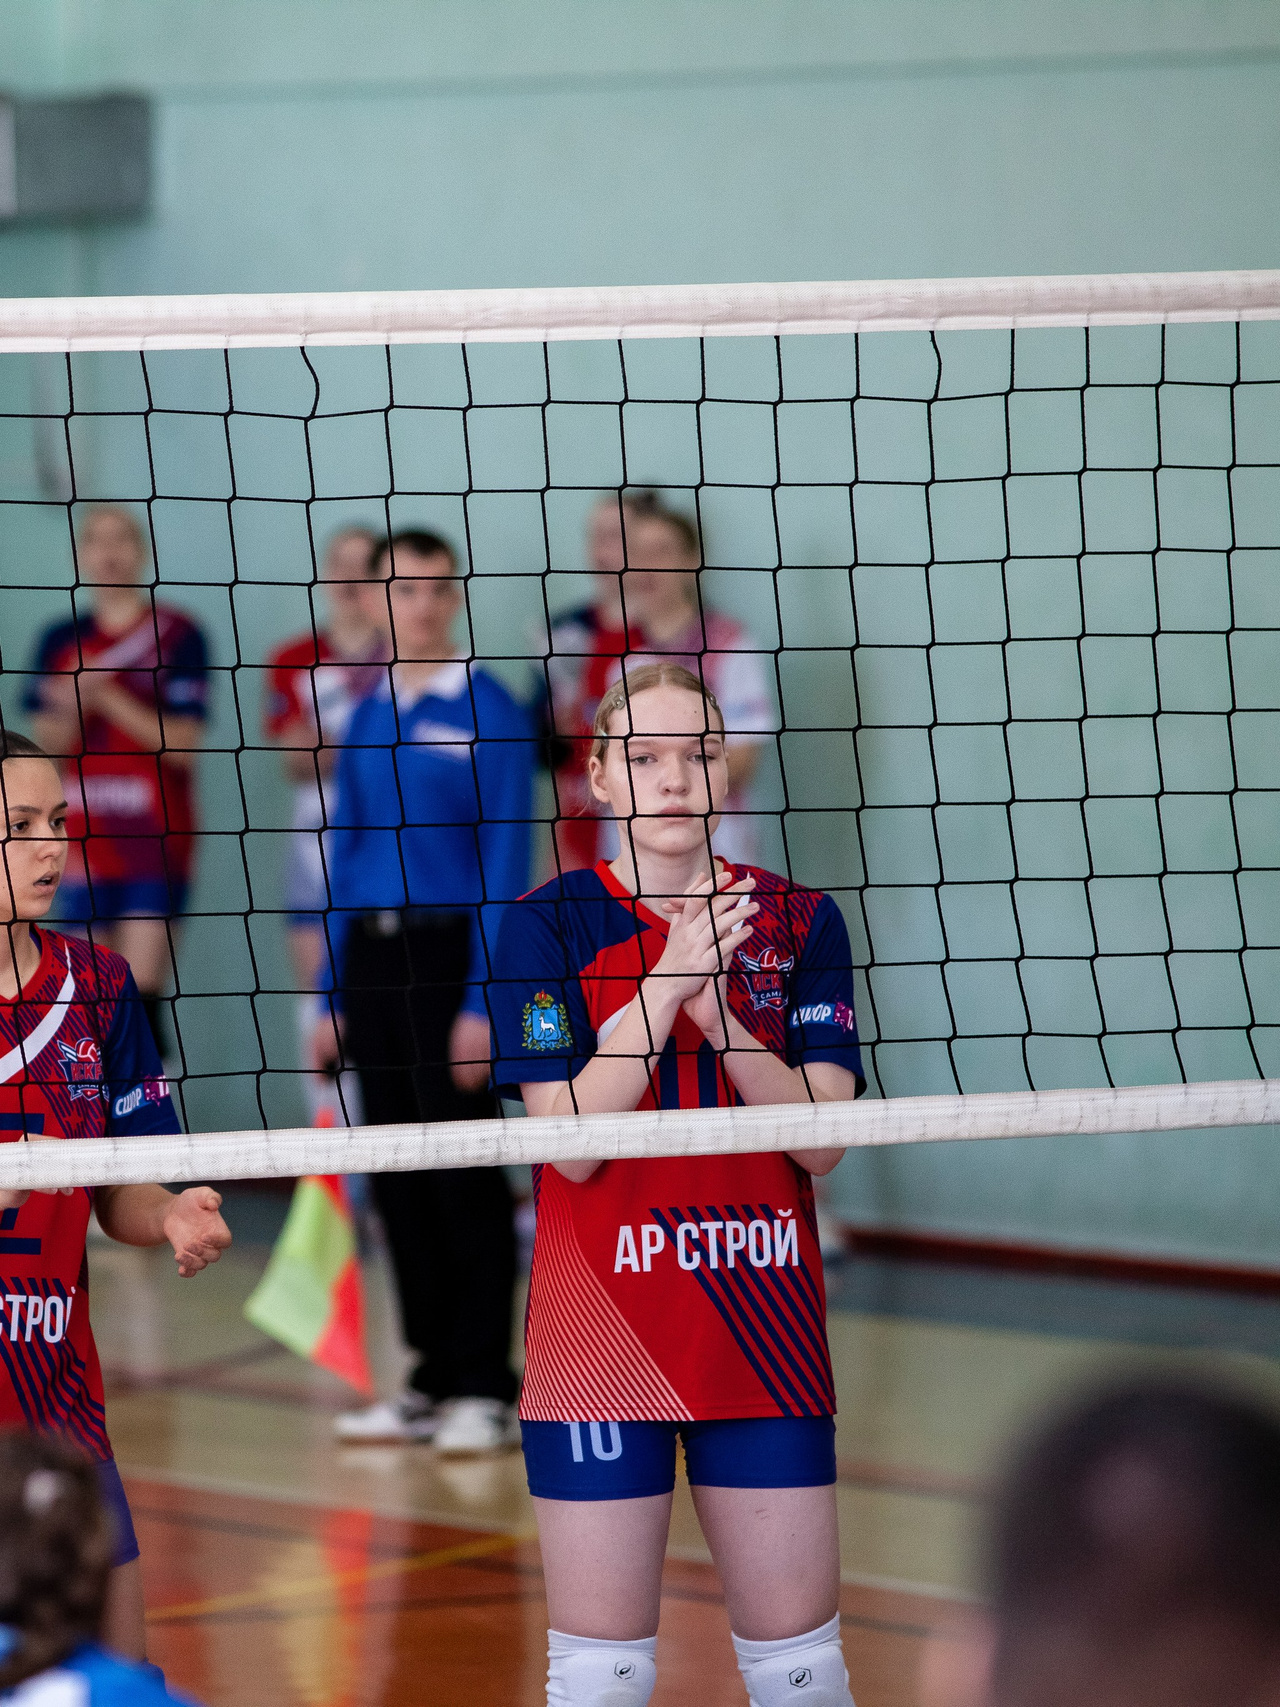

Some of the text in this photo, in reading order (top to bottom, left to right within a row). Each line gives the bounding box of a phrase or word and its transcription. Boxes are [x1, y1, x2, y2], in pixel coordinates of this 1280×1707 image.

[614, 1208, 799, 1273] АР СТРОЙ
[563, 1422, 623, 1463] 10
